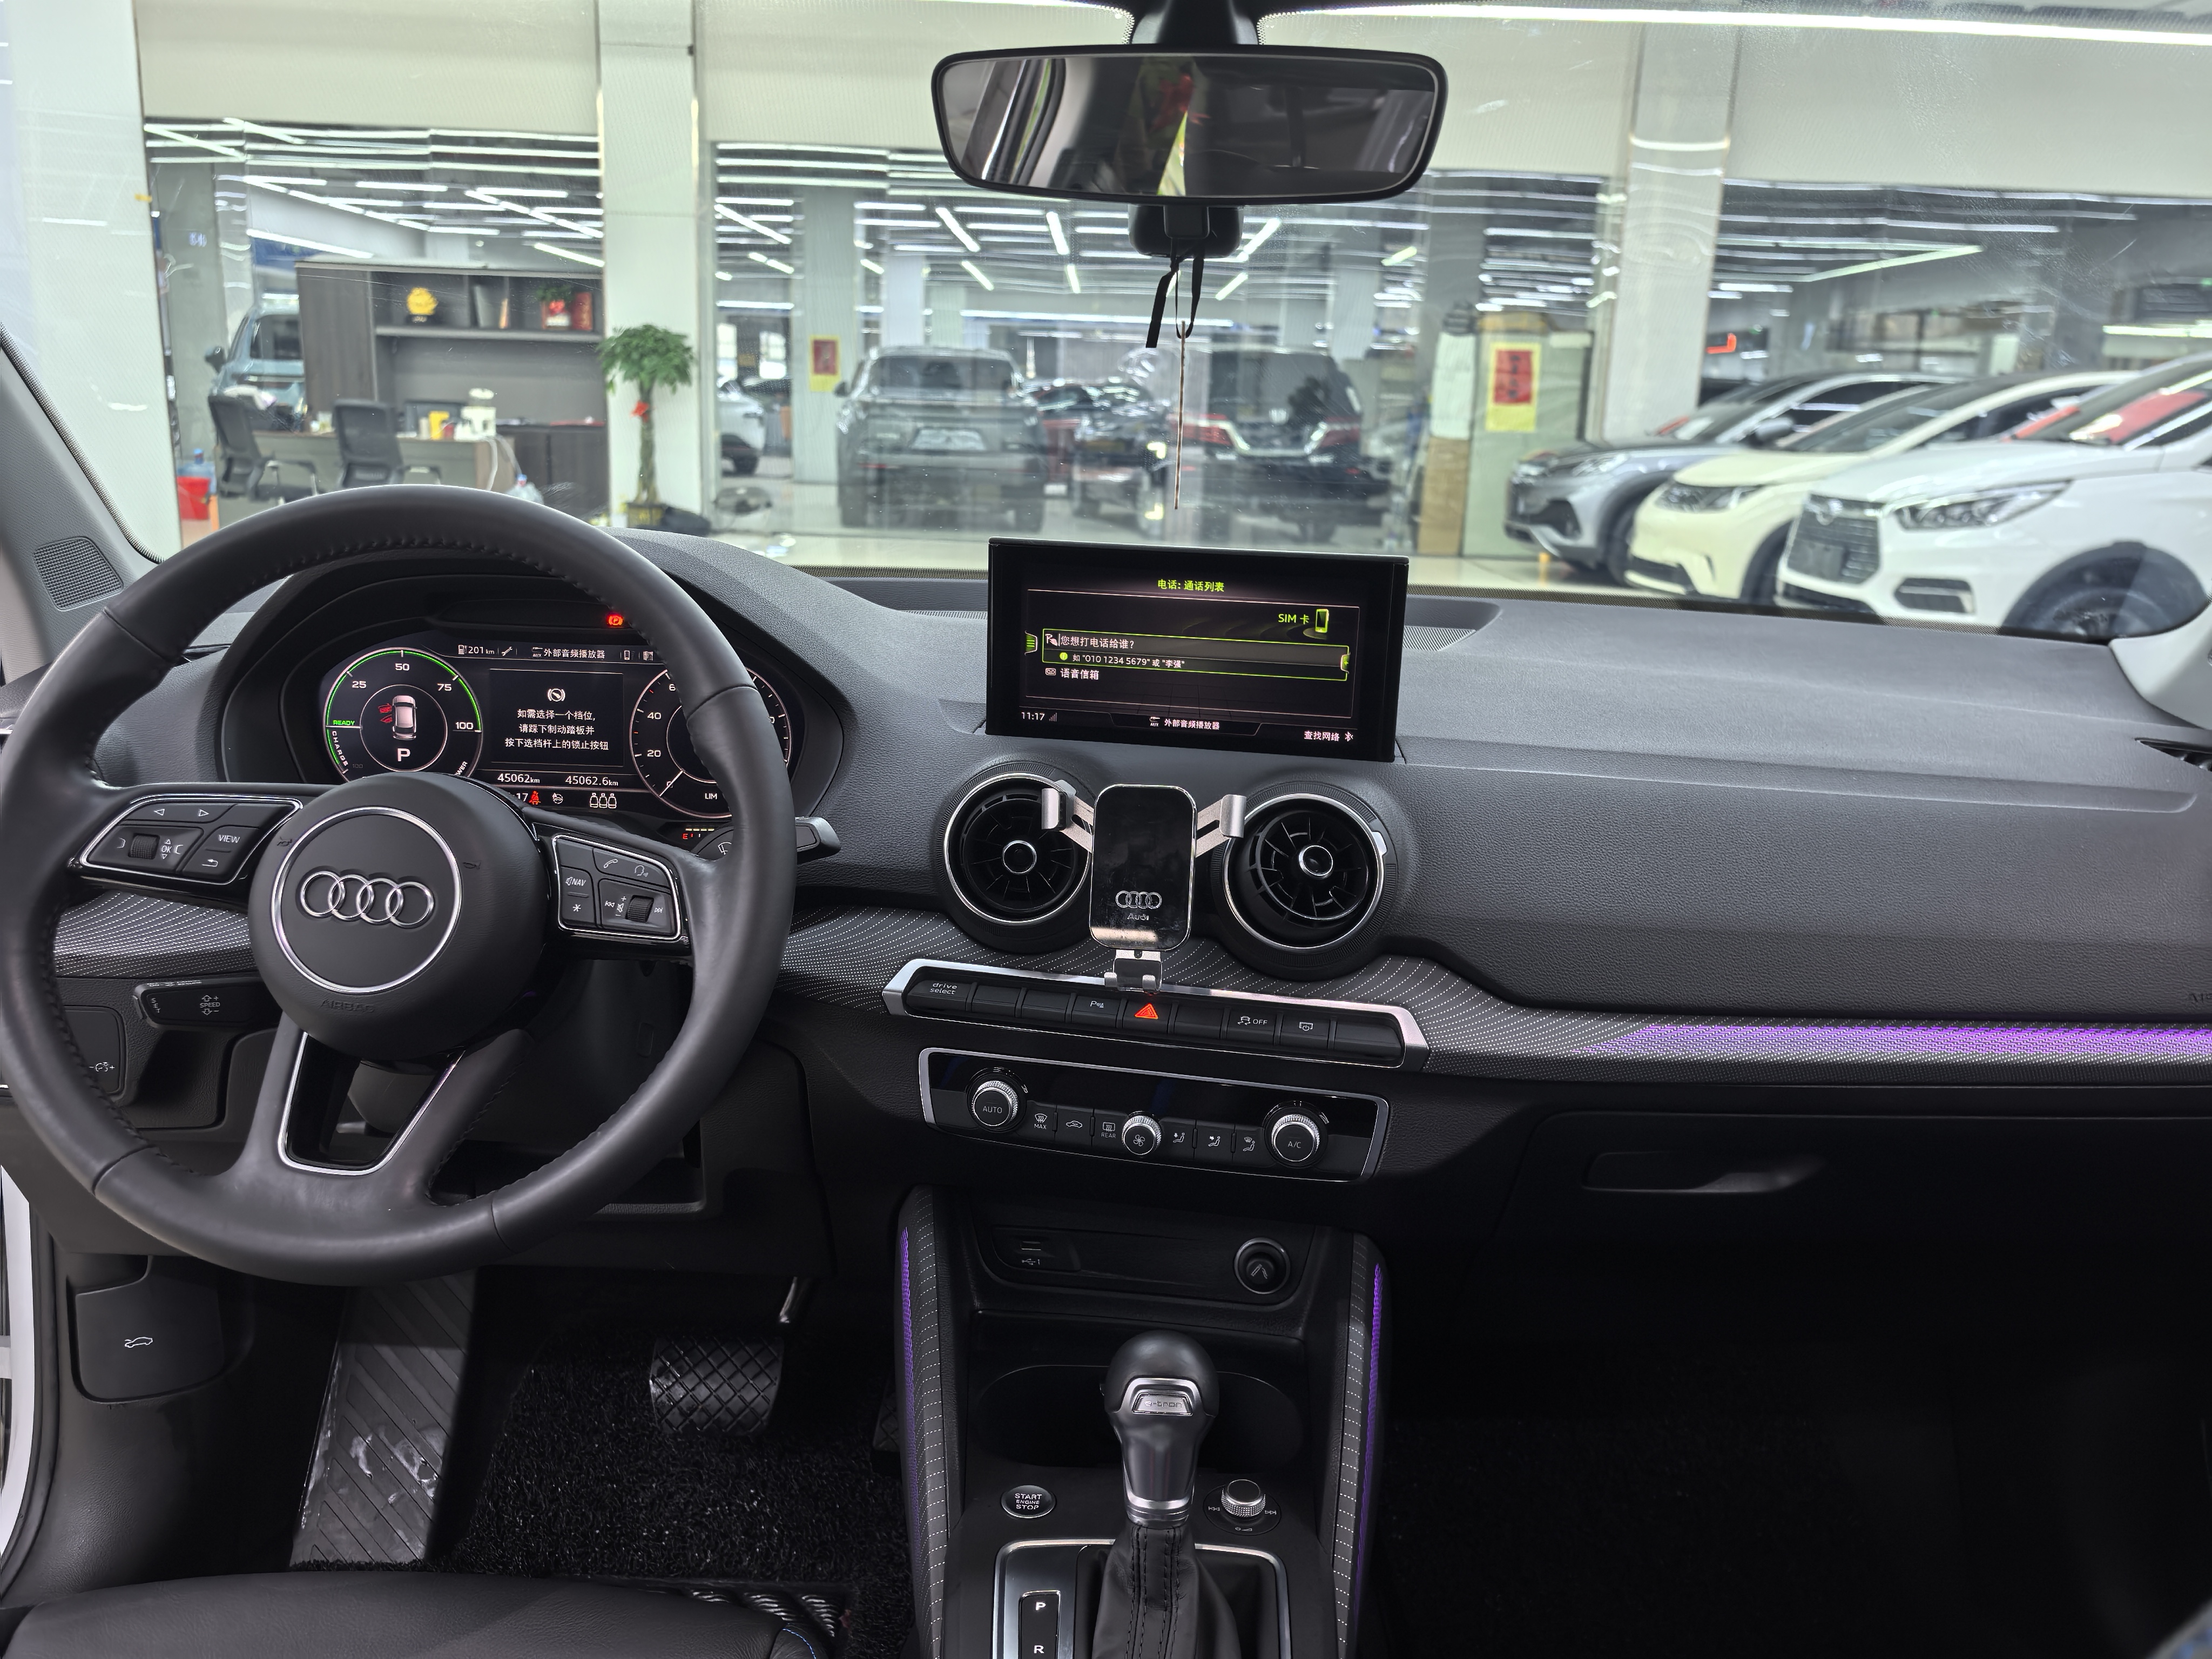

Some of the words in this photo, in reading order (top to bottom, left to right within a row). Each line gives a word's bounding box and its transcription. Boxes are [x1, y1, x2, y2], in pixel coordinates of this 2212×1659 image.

[1158, 579, 1181, 590] 电话:
[1184, 581, 1225, 592] 通话列表
[1278, 614, 1297, 623] SIM
[1300, 614, 1310, 624] 卡
[1061, 635, 1134, 649] 您想打电话给谁?
[543, 648, 605, 659] 外部音频播放器
[1073, 653, 1080, 662] 如
[1103, 656, 1124, 664] 1234
[1152, 659, 1160, 667] 或
[395, 663, 409, 671] 50
[1060, 668, 1100, 680] 语音信箱
[437, 683, 452, 691] 75
[1021, 712, 1045, 721] 11:17
[455, 721, 474, 730] 100
[1164, 718, 1220, 730] 外部音频播放器
[519, 724, 595, 736] 请踩下制动踏板并
[1304, 731, 1340, 742] 查找网络
[505, 738, 609, 750] 按下选档杆上的锁止按钮
[397, 748, 410, 761] P
[218, 834, 240, 844] VIEW
[161, 845, 172, 853] OK
[571, 878, 586, 886] NAV
[1127, 913, 1149, 921] Audi
[982, 1105, 1002, 1114] AUTO
[1287, 1141, 1301, 1149] A/C
[1035, 1602, 1046, 1610] P
[1034, 1645, 1044, 1654] R
